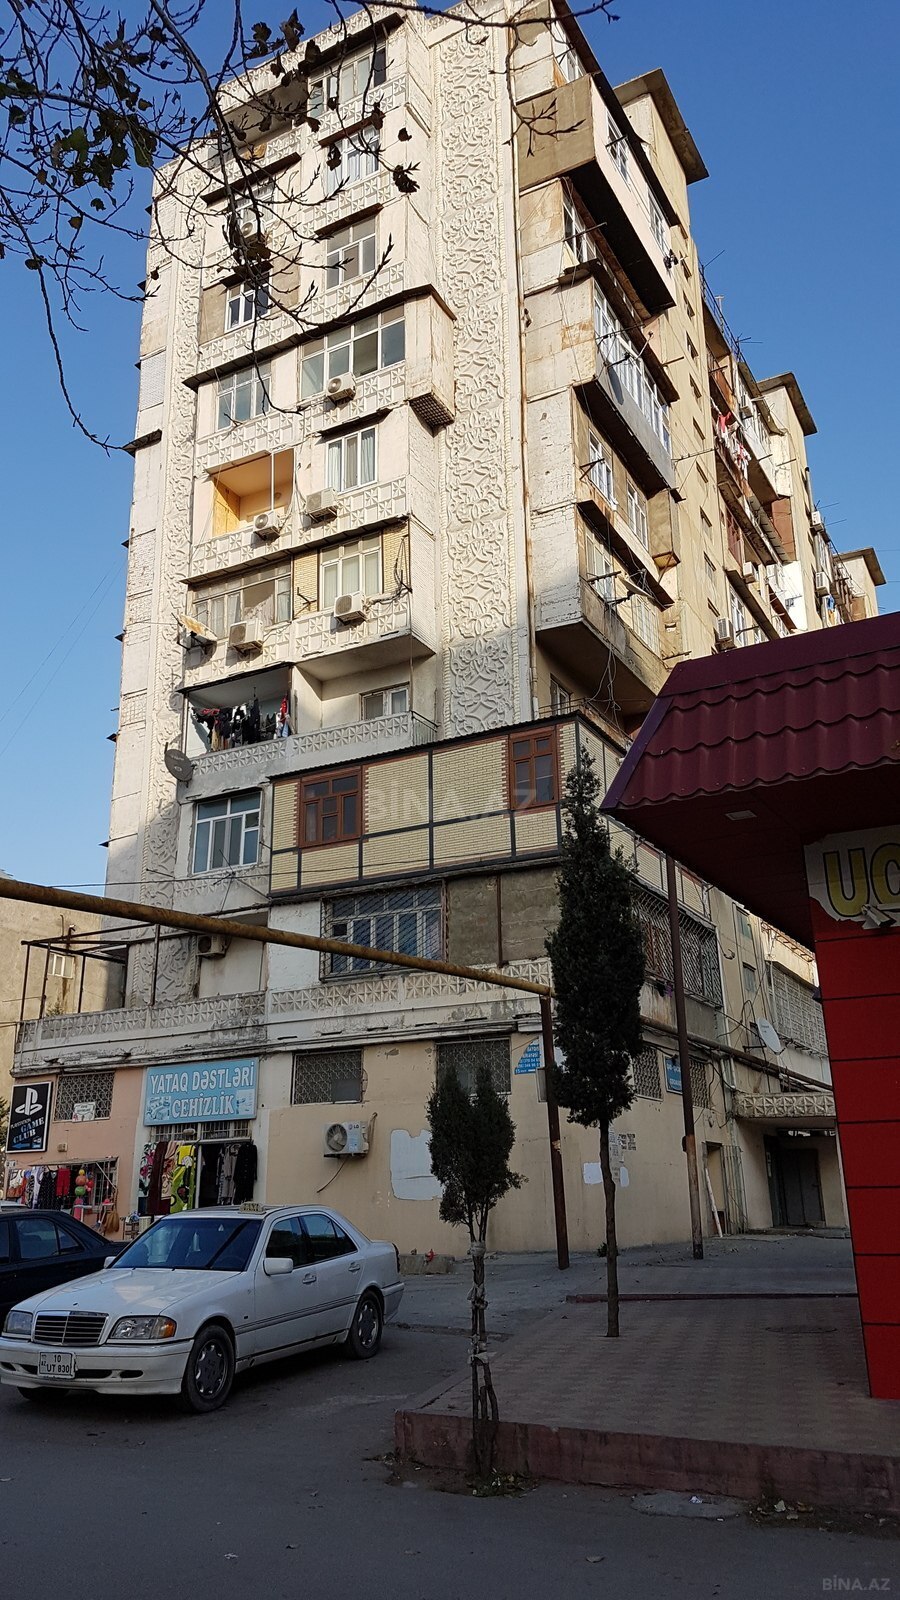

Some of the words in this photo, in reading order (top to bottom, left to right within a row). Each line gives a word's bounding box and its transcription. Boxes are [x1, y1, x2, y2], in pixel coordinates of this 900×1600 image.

[150, 1072, 188, 1094] YATAQ
[192, 1061, 255, 1091] DƏSTLƏRİ
[171, 1091, 234, 1119] CEHİZLİK
[20, 1116, 44, 1133] GAME
[13, 1128, 36, 1144] CLUB
[46, 1364, 56, 1372] UT
[58, 1364, 70, 1373] 830
